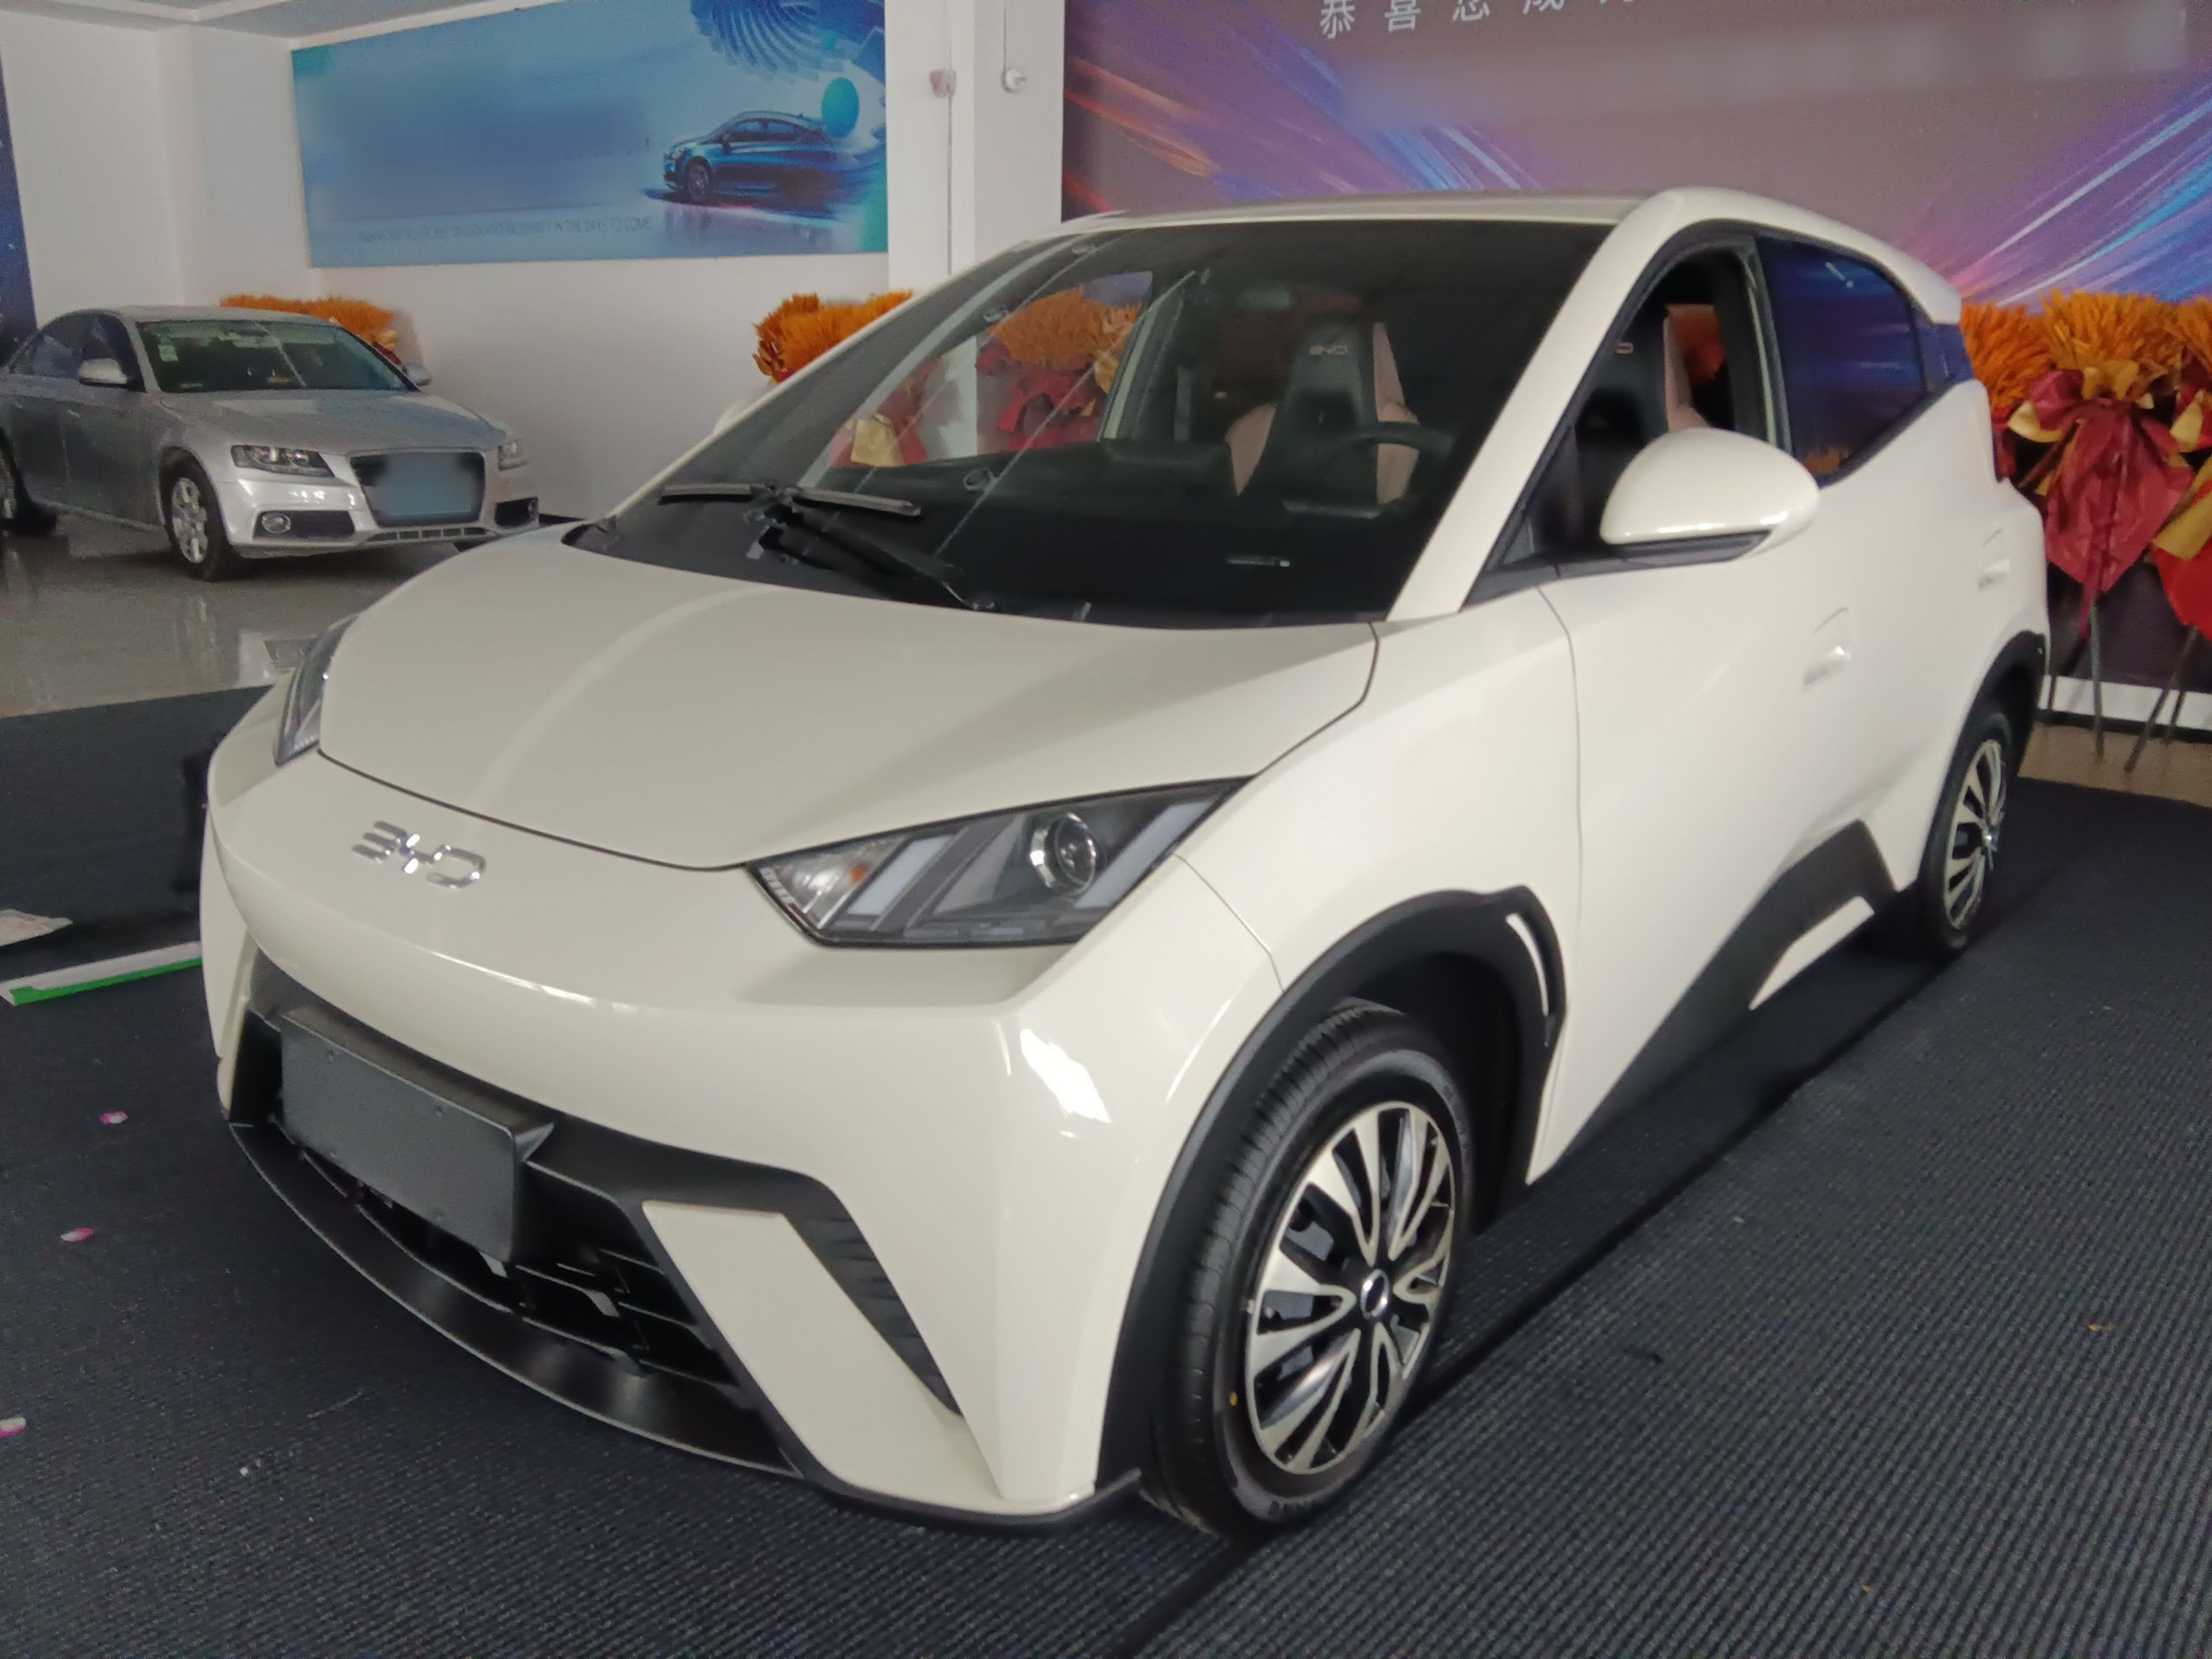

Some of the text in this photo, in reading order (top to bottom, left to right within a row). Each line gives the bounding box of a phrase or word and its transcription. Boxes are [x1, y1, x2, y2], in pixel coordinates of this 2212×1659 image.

[1320, 0, 1634, 39] 恭喜您
[351, 820, 487, 891] BYD
